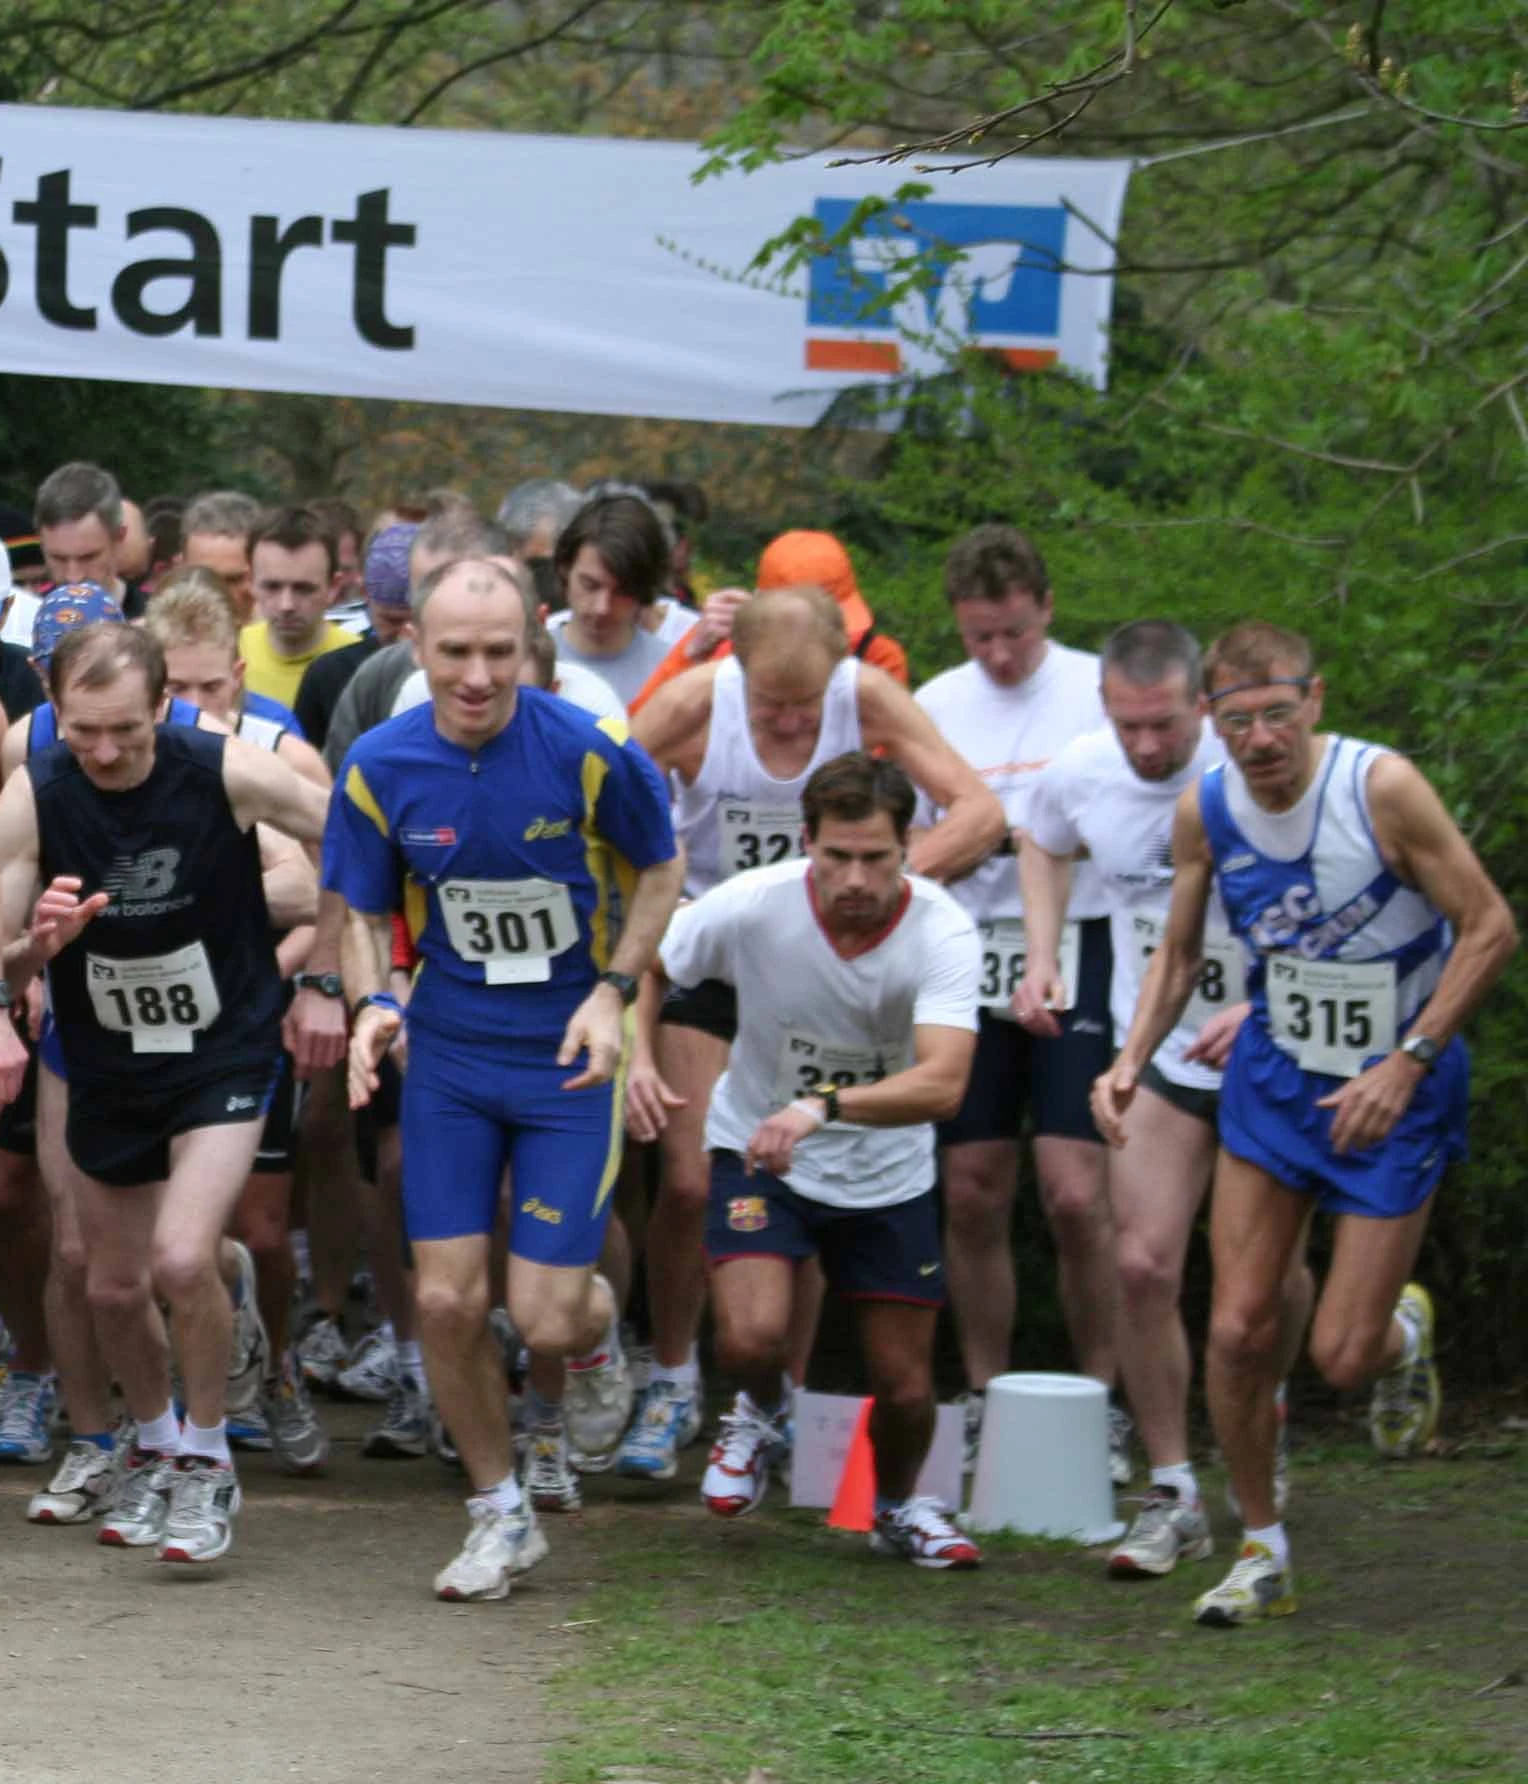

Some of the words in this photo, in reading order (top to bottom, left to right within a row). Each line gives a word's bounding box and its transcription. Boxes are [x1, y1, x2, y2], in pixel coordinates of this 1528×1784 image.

[735, 833, 807, 870] 32
[95, 903, 121, 918] ew
[463, 908, 556, 954] 301
[978, 951, 1029, 997] 38
[106, 983, 199, 1026] 188
[1287, 993, 1370, 1048] 315
